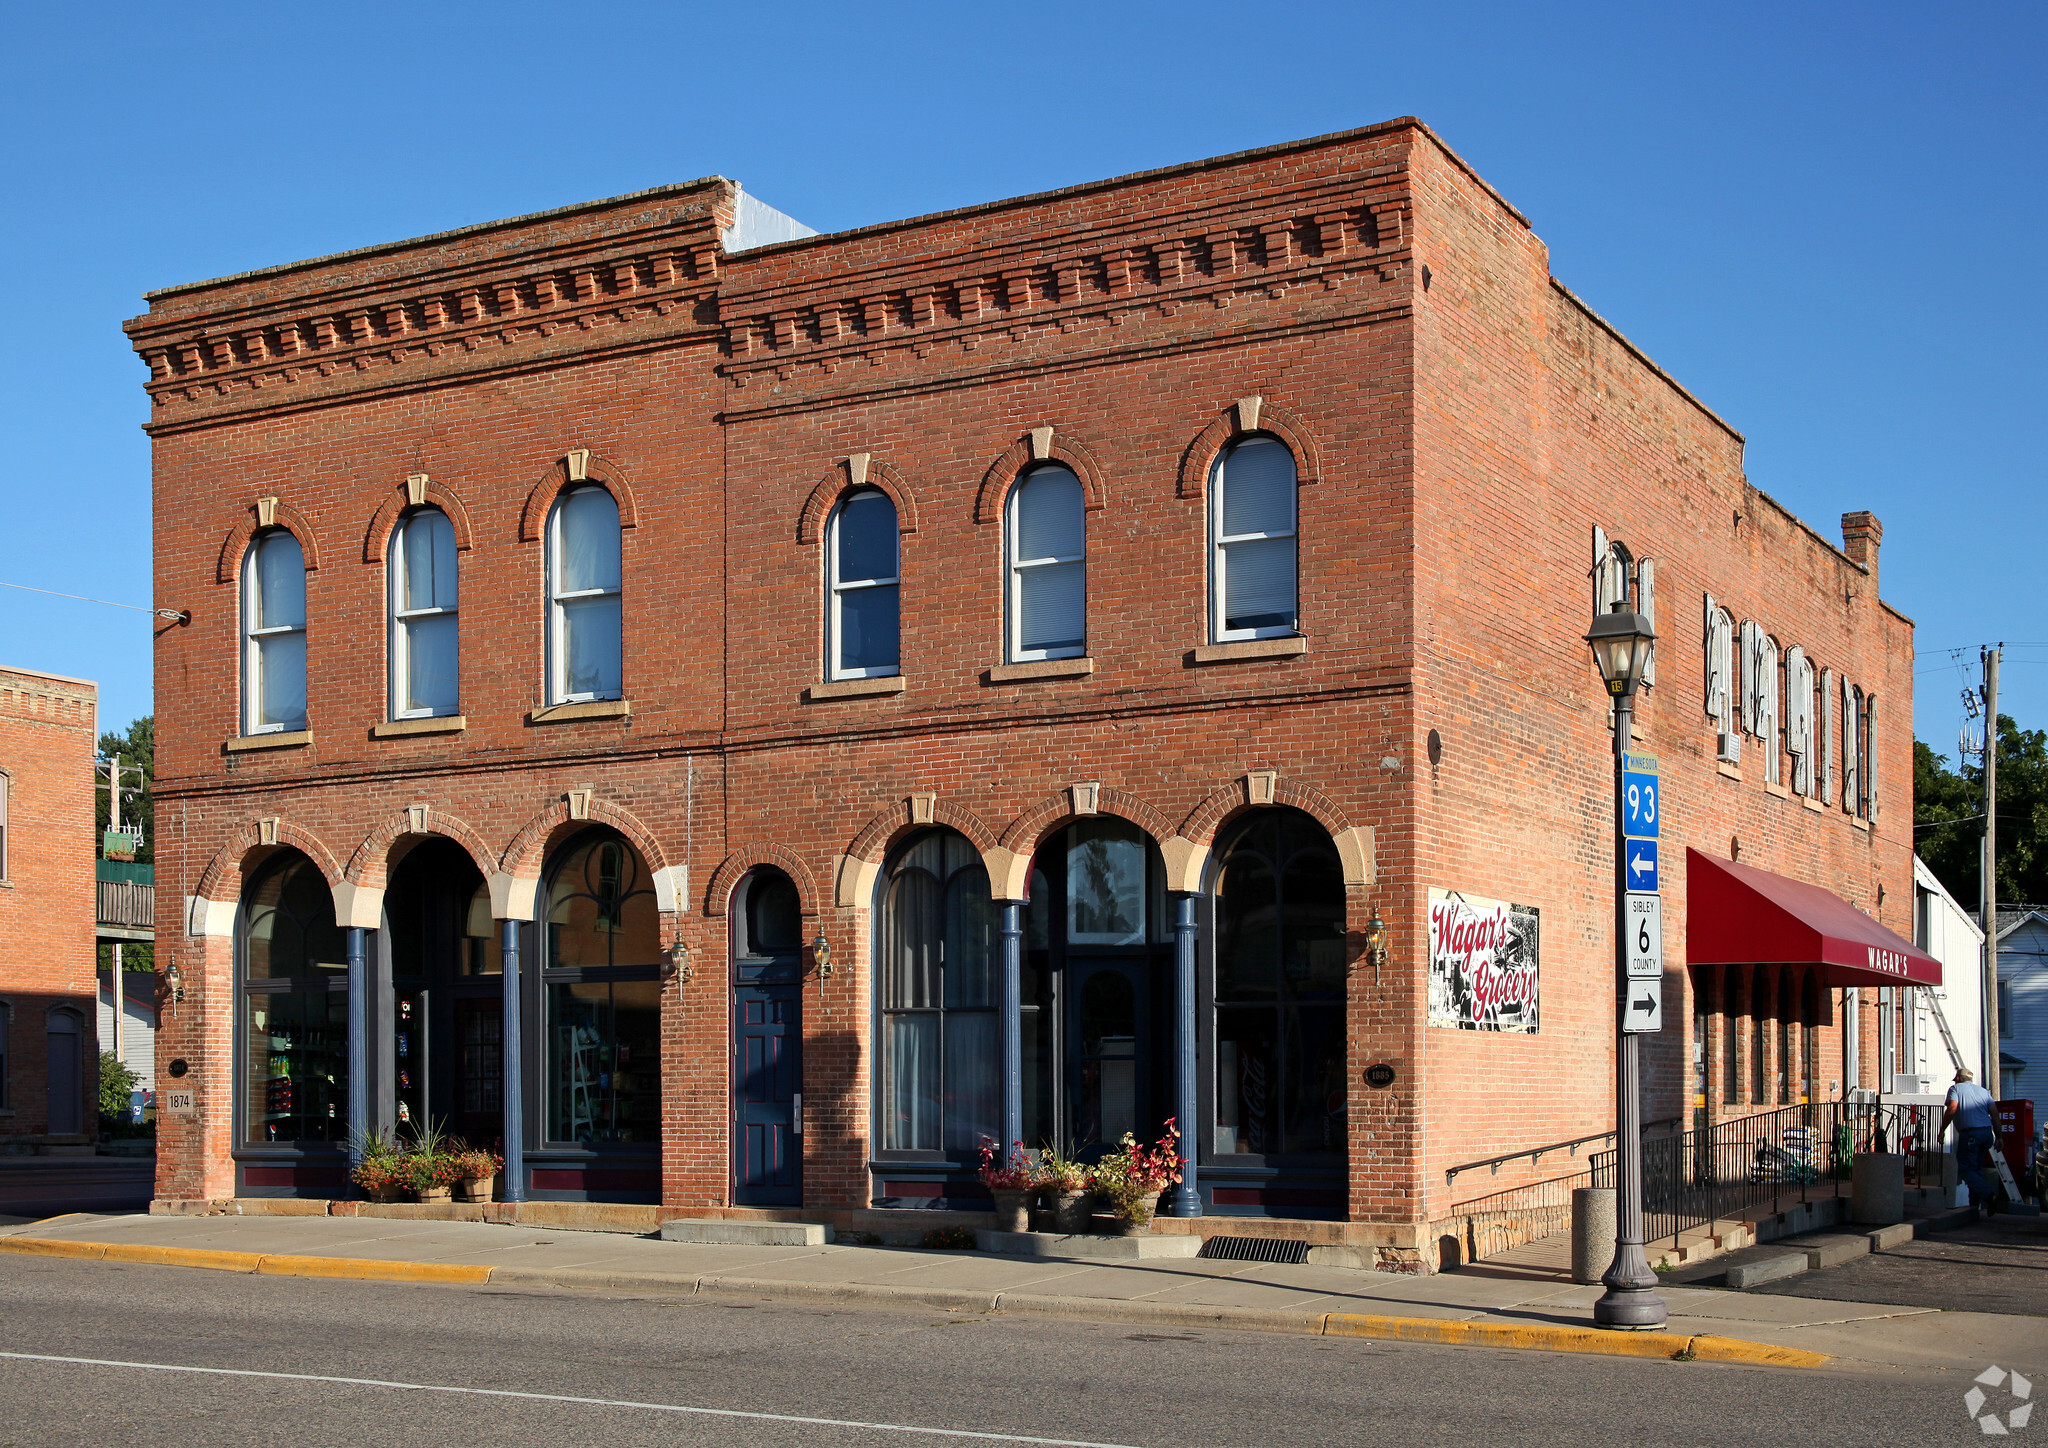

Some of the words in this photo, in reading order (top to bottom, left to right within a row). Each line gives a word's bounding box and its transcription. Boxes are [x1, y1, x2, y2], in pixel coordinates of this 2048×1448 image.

[1612, 681, 1622, 691] 15
[1630, 755, 1658, 771] MINNESOTA
[1627, 783, 1656, 824] 93
[1632, 900, 1655, 913] SIBLEY
[1432, 904, 1507, 973] Wagar's
[1638, 917, 1650, 954] 6
[1632, 958, 1657, 970] COUNTY
[1868, 946, 1908, 976] WAGAR'S
[1471, 960, 1536, 1021] Grocery
[1371, 1071, 1390, 1080] 1885
[170, 1095, 190, 1108] 1874
